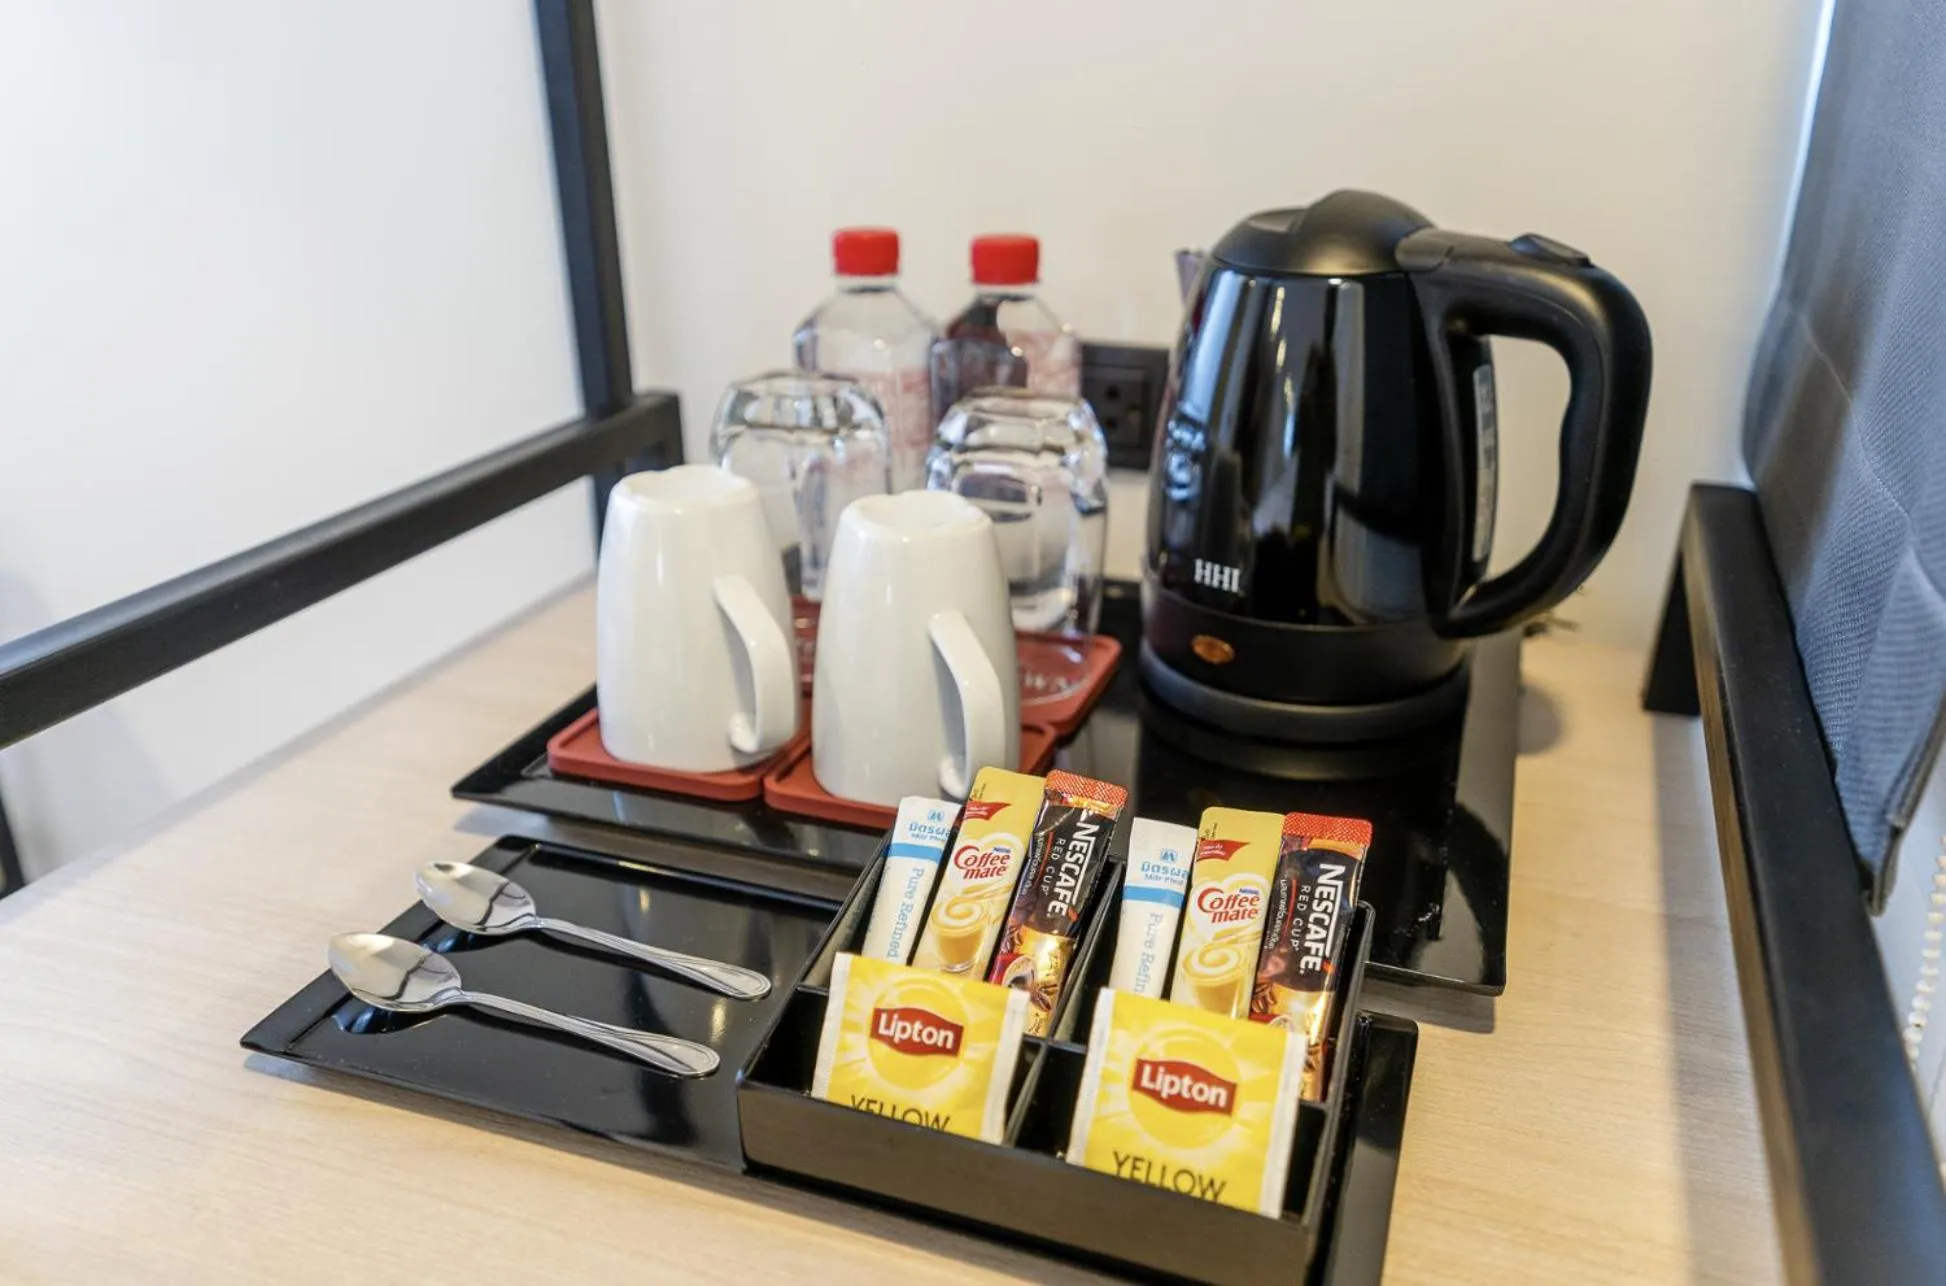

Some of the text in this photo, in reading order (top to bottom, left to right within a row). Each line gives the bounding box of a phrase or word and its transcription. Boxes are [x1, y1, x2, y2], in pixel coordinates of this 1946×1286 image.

[954, 845, 1011, 870] Coffee
[963, 866, 1007, 880] mate
[1041, 838, 1066, 892] RED CUP
[1197, 887, 1260, 913] Coffee
[1211, 908, 1258, 923] mate
[1290, 885, 1311, 949] RED CUP
[877, 1012, 955, 1051] Lipton
[1139, 1063, 1229, 1109] Lipton
[1112, 1150, 1227, 1204] YELLOW
